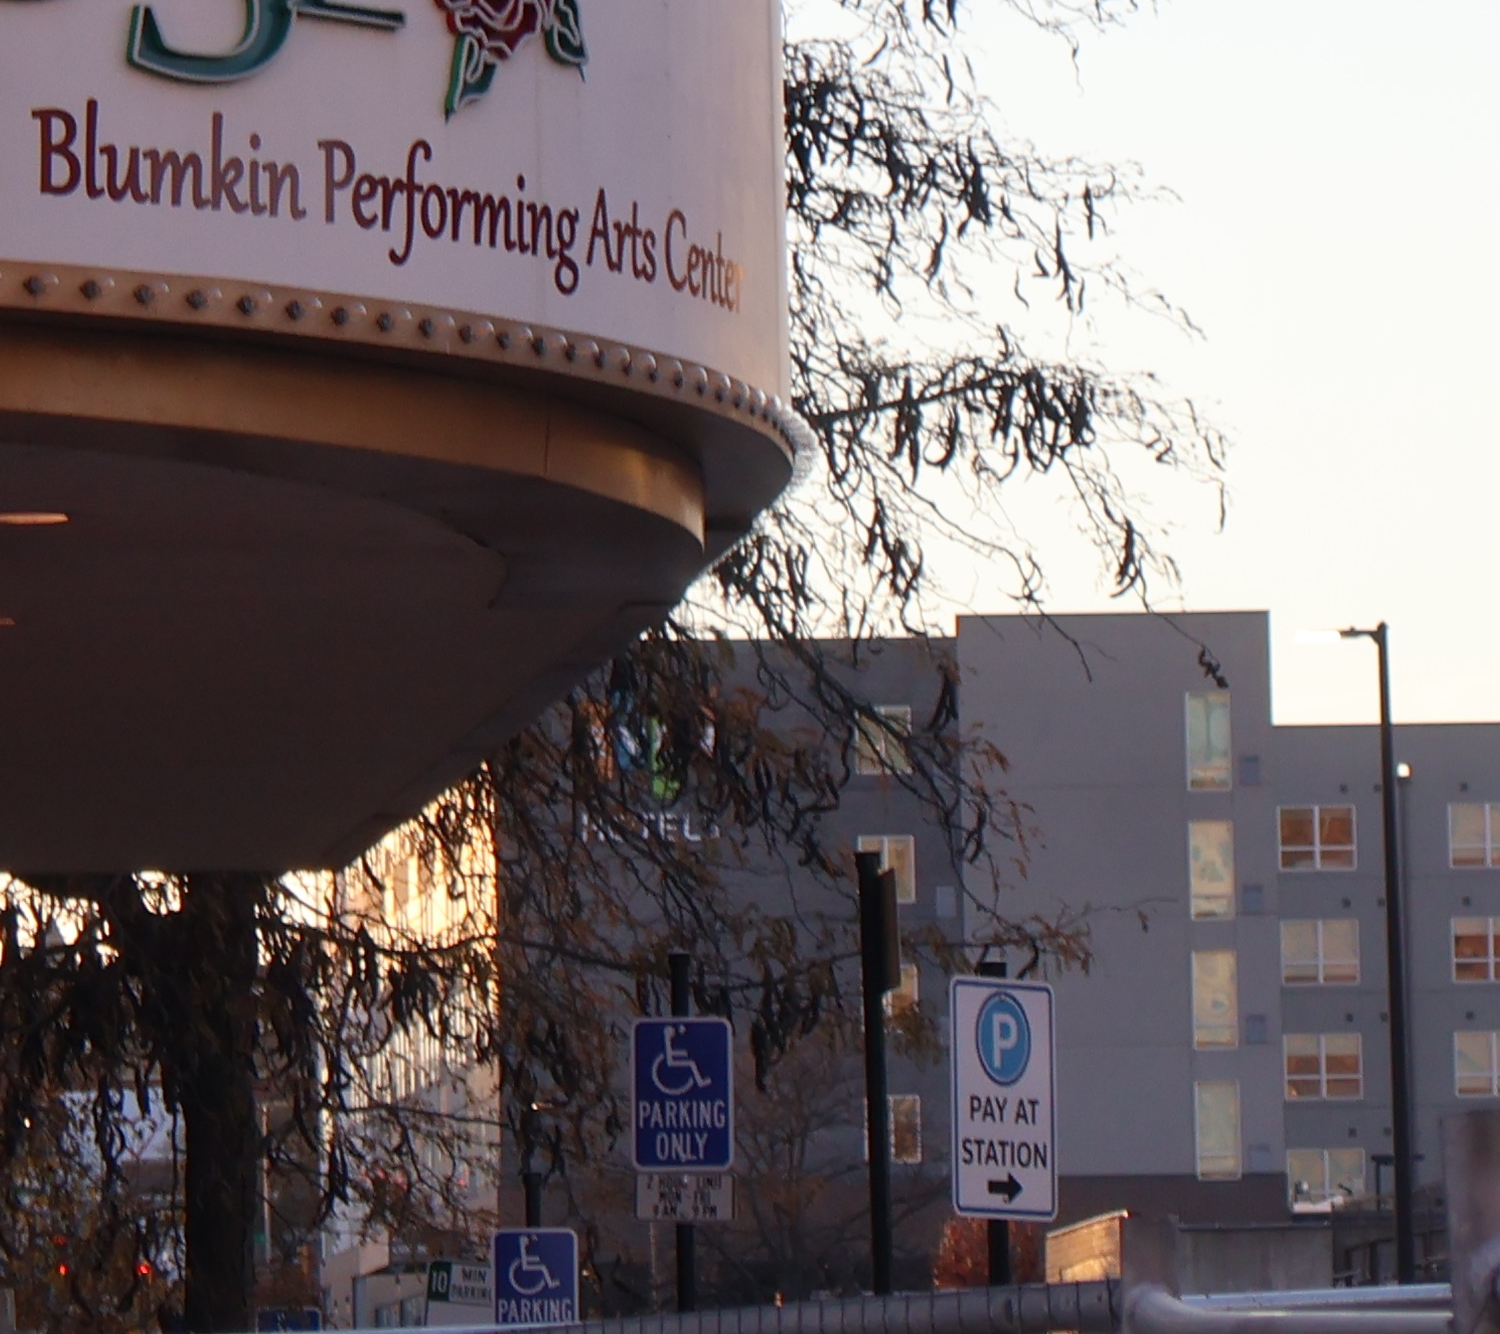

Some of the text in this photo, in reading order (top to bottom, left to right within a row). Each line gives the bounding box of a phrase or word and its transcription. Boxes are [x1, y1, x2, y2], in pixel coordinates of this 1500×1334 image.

[31, 98, 747, 315] Blumkin Performing Arts Center
[992, 1012, 1019, 1070] P
[638, 1099, 726, 1130] PARKING
[969, 1094, 1040, 1126] PAY AT
[655, 1132, 708, 1162] ONLY
[962, 1138, 1048, 1169] STATION
[432, 1267, 487, 1294] 10 MIN
[497, 1298, 573, 1324] PARKING
